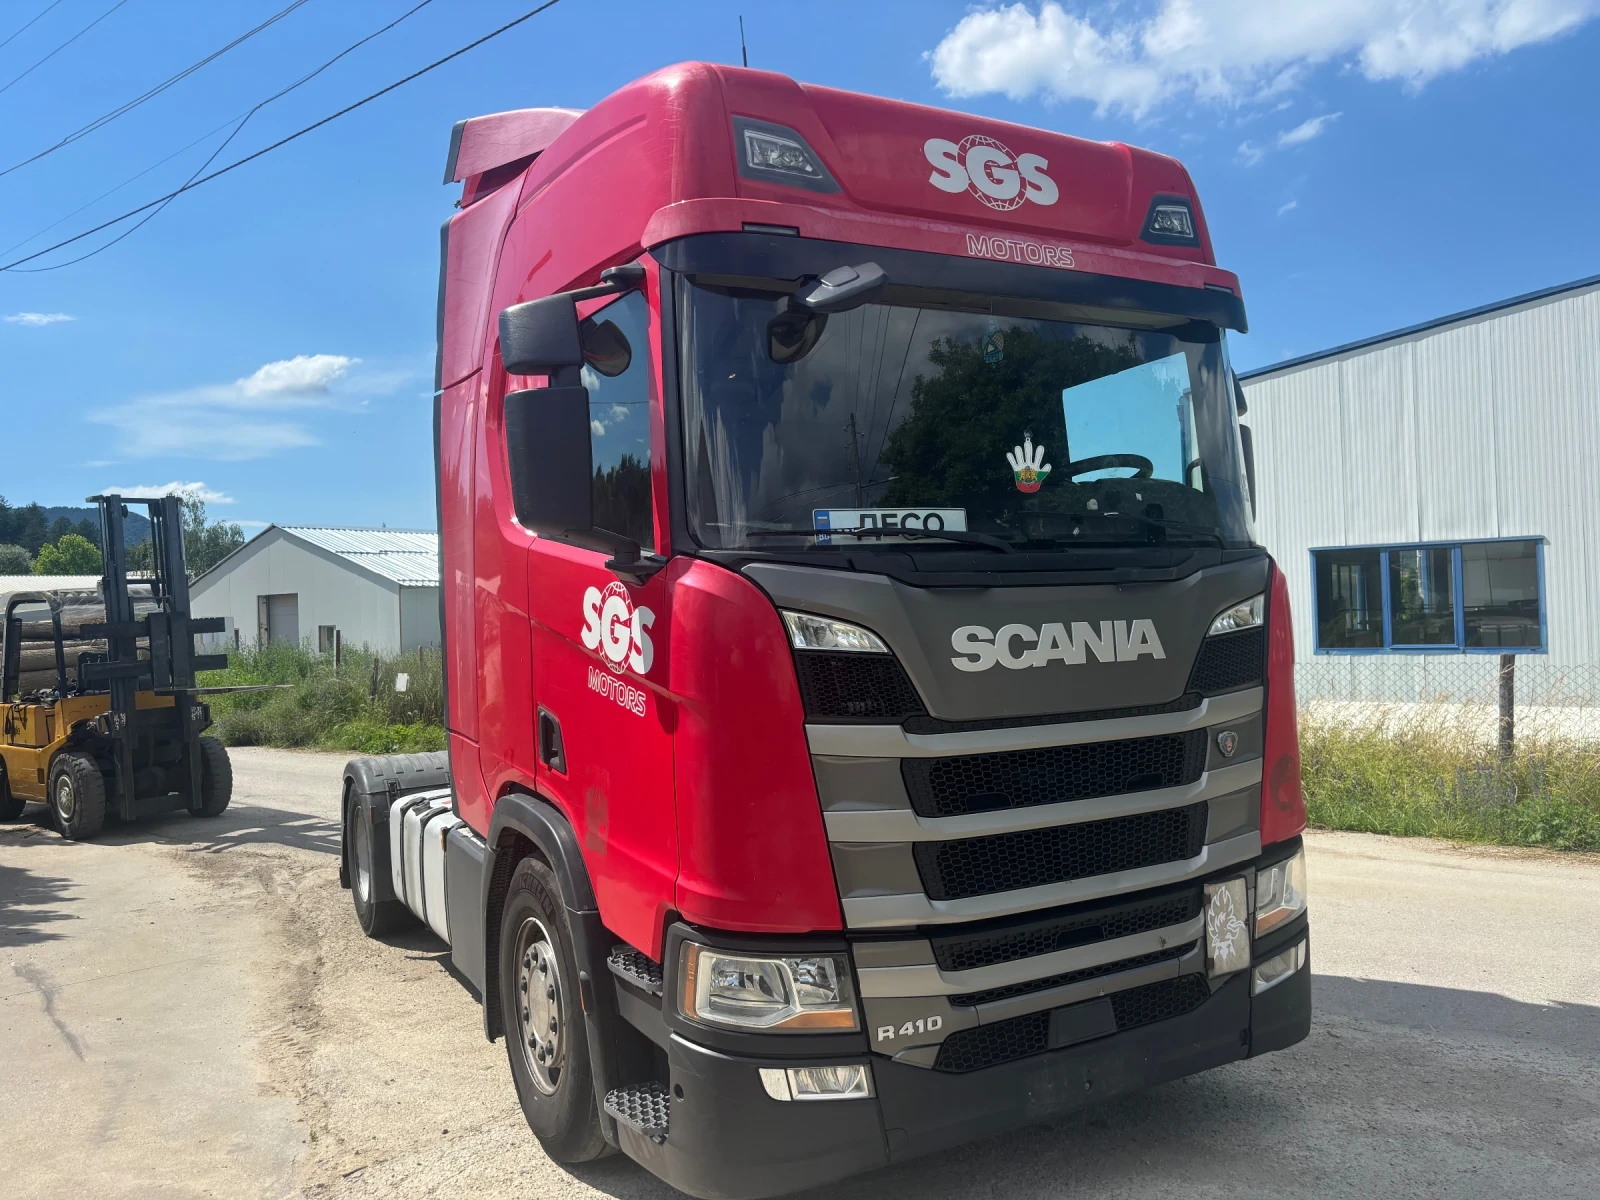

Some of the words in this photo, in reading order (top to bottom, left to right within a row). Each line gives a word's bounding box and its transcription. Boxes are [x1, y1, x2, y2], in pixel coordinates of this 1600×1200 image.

[923, 136, 1060, 208] SGS
[966, 233, 1075, 268] MOTORS
[580, 584, 656, 675] SGS
[950, 618, 1167, 672] SCANIA
[588, 665, 646, 717] MOTORS
[877, 1025, 895, 1041] R
[898, 1015, 943, 1036] 410
